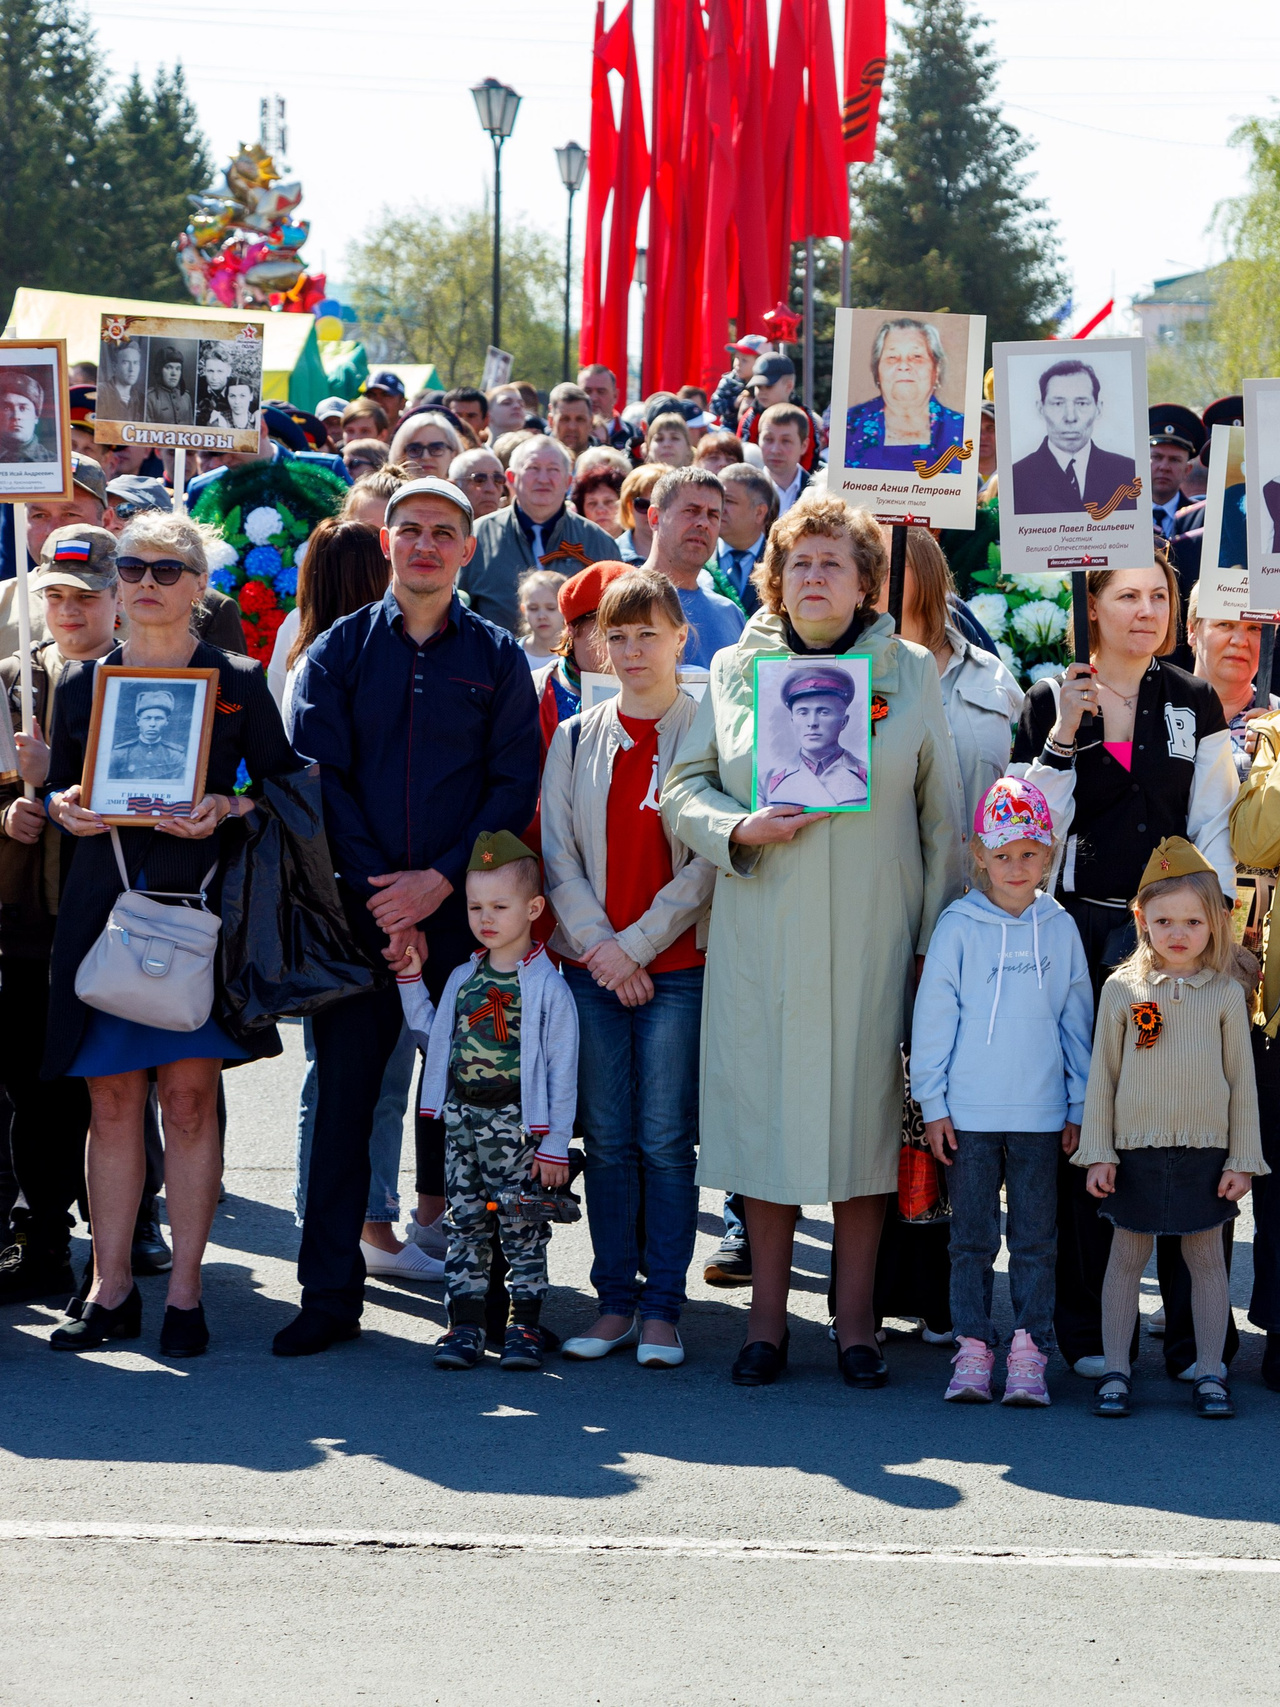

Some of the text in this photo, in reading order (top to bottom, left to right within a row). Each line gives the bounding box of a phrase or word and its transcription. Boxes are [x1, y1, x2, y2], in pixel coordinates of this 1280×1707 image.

[121, 424, 235, 449] Симаковы
[842, 481, 961, 497] Ионова Агния Петровна
[876, 497, 907, 506] Труженик
[1018, 523, 1135, 536] Кузнецов Павел Васильевич
[1025, 545, 1053, 553] Великой
[1053, 543, 1107, 552] Отечественной
[1217, 584, 1248, 594] Конста
[1223, 600, 1248, 608] Великой
[986, 955, 1051, 984] yurself
